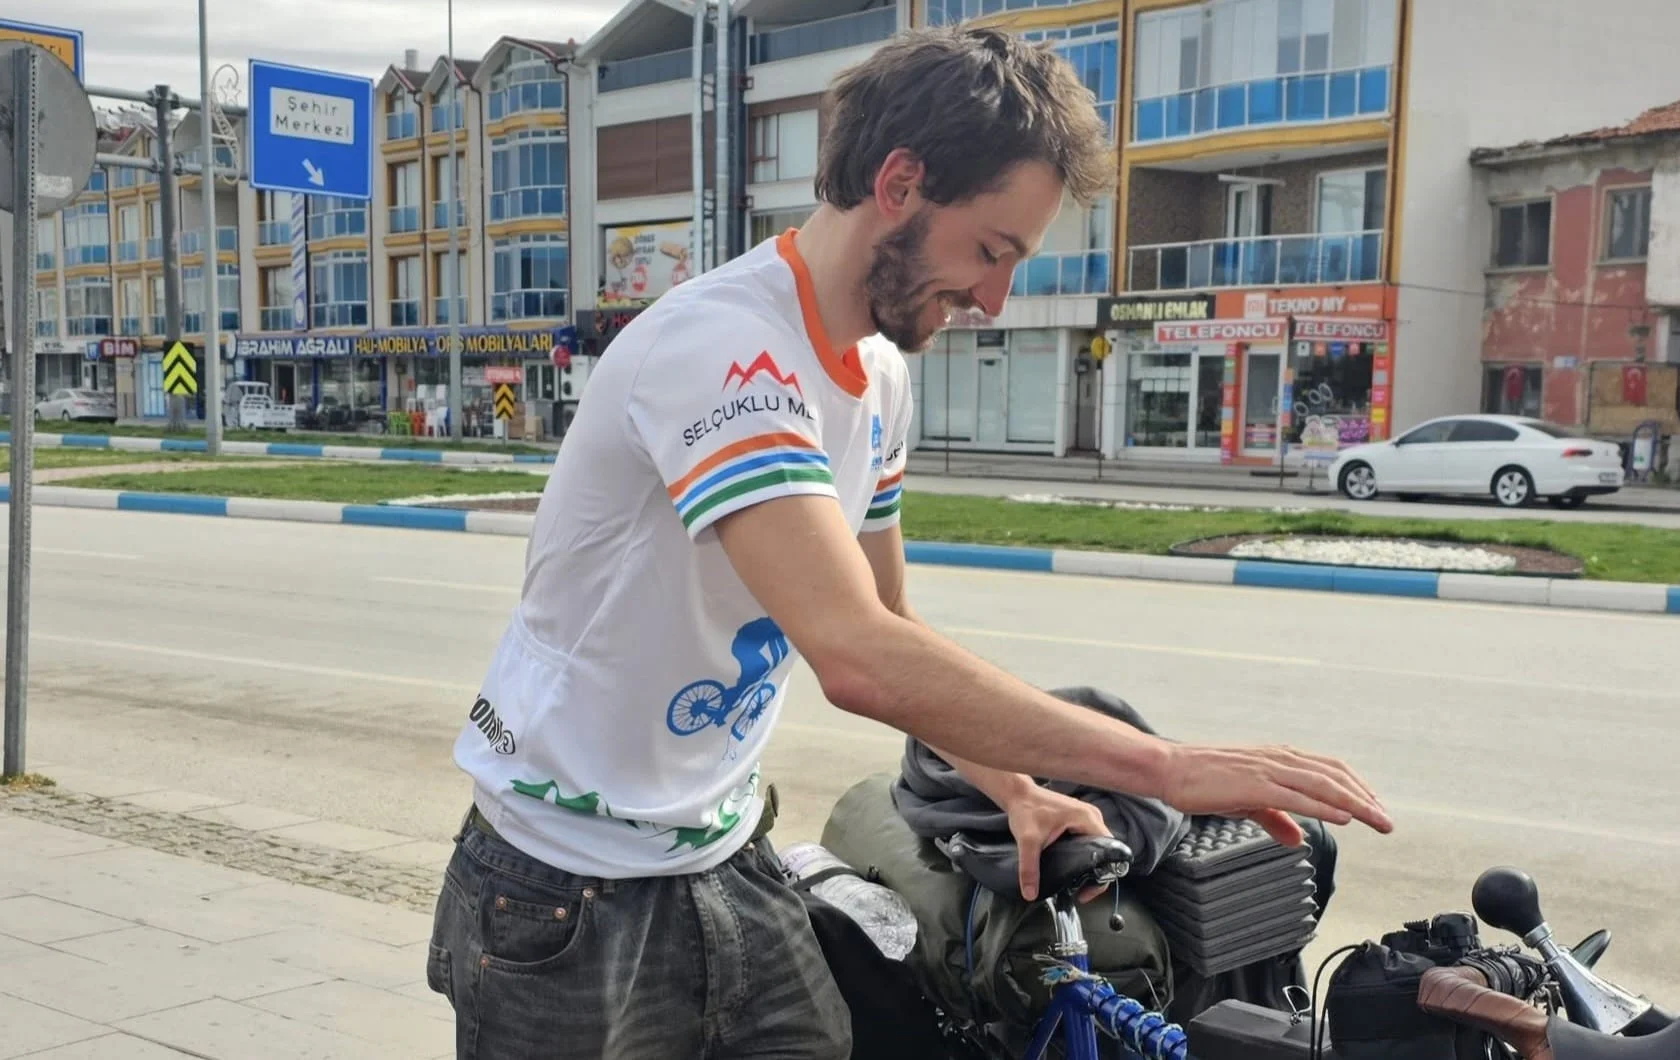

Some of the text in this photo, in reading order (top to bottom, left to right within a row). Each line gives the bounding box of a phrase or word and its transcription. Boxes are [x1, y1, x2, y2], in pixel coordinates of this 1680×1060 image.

[287, 96, 338, 116] Şehir
[275, 114, 350, 137] Merkezi
[1164, 301, 1209, 319] EMLAK
[1269, 298, 1320, 314] TEKNO
[1163, 323, 1281, 340] TELEFONCU
[1294, 321, 1384, 337] TELEFONCU
[683, 394, 780, 447] SELÇUKLU
